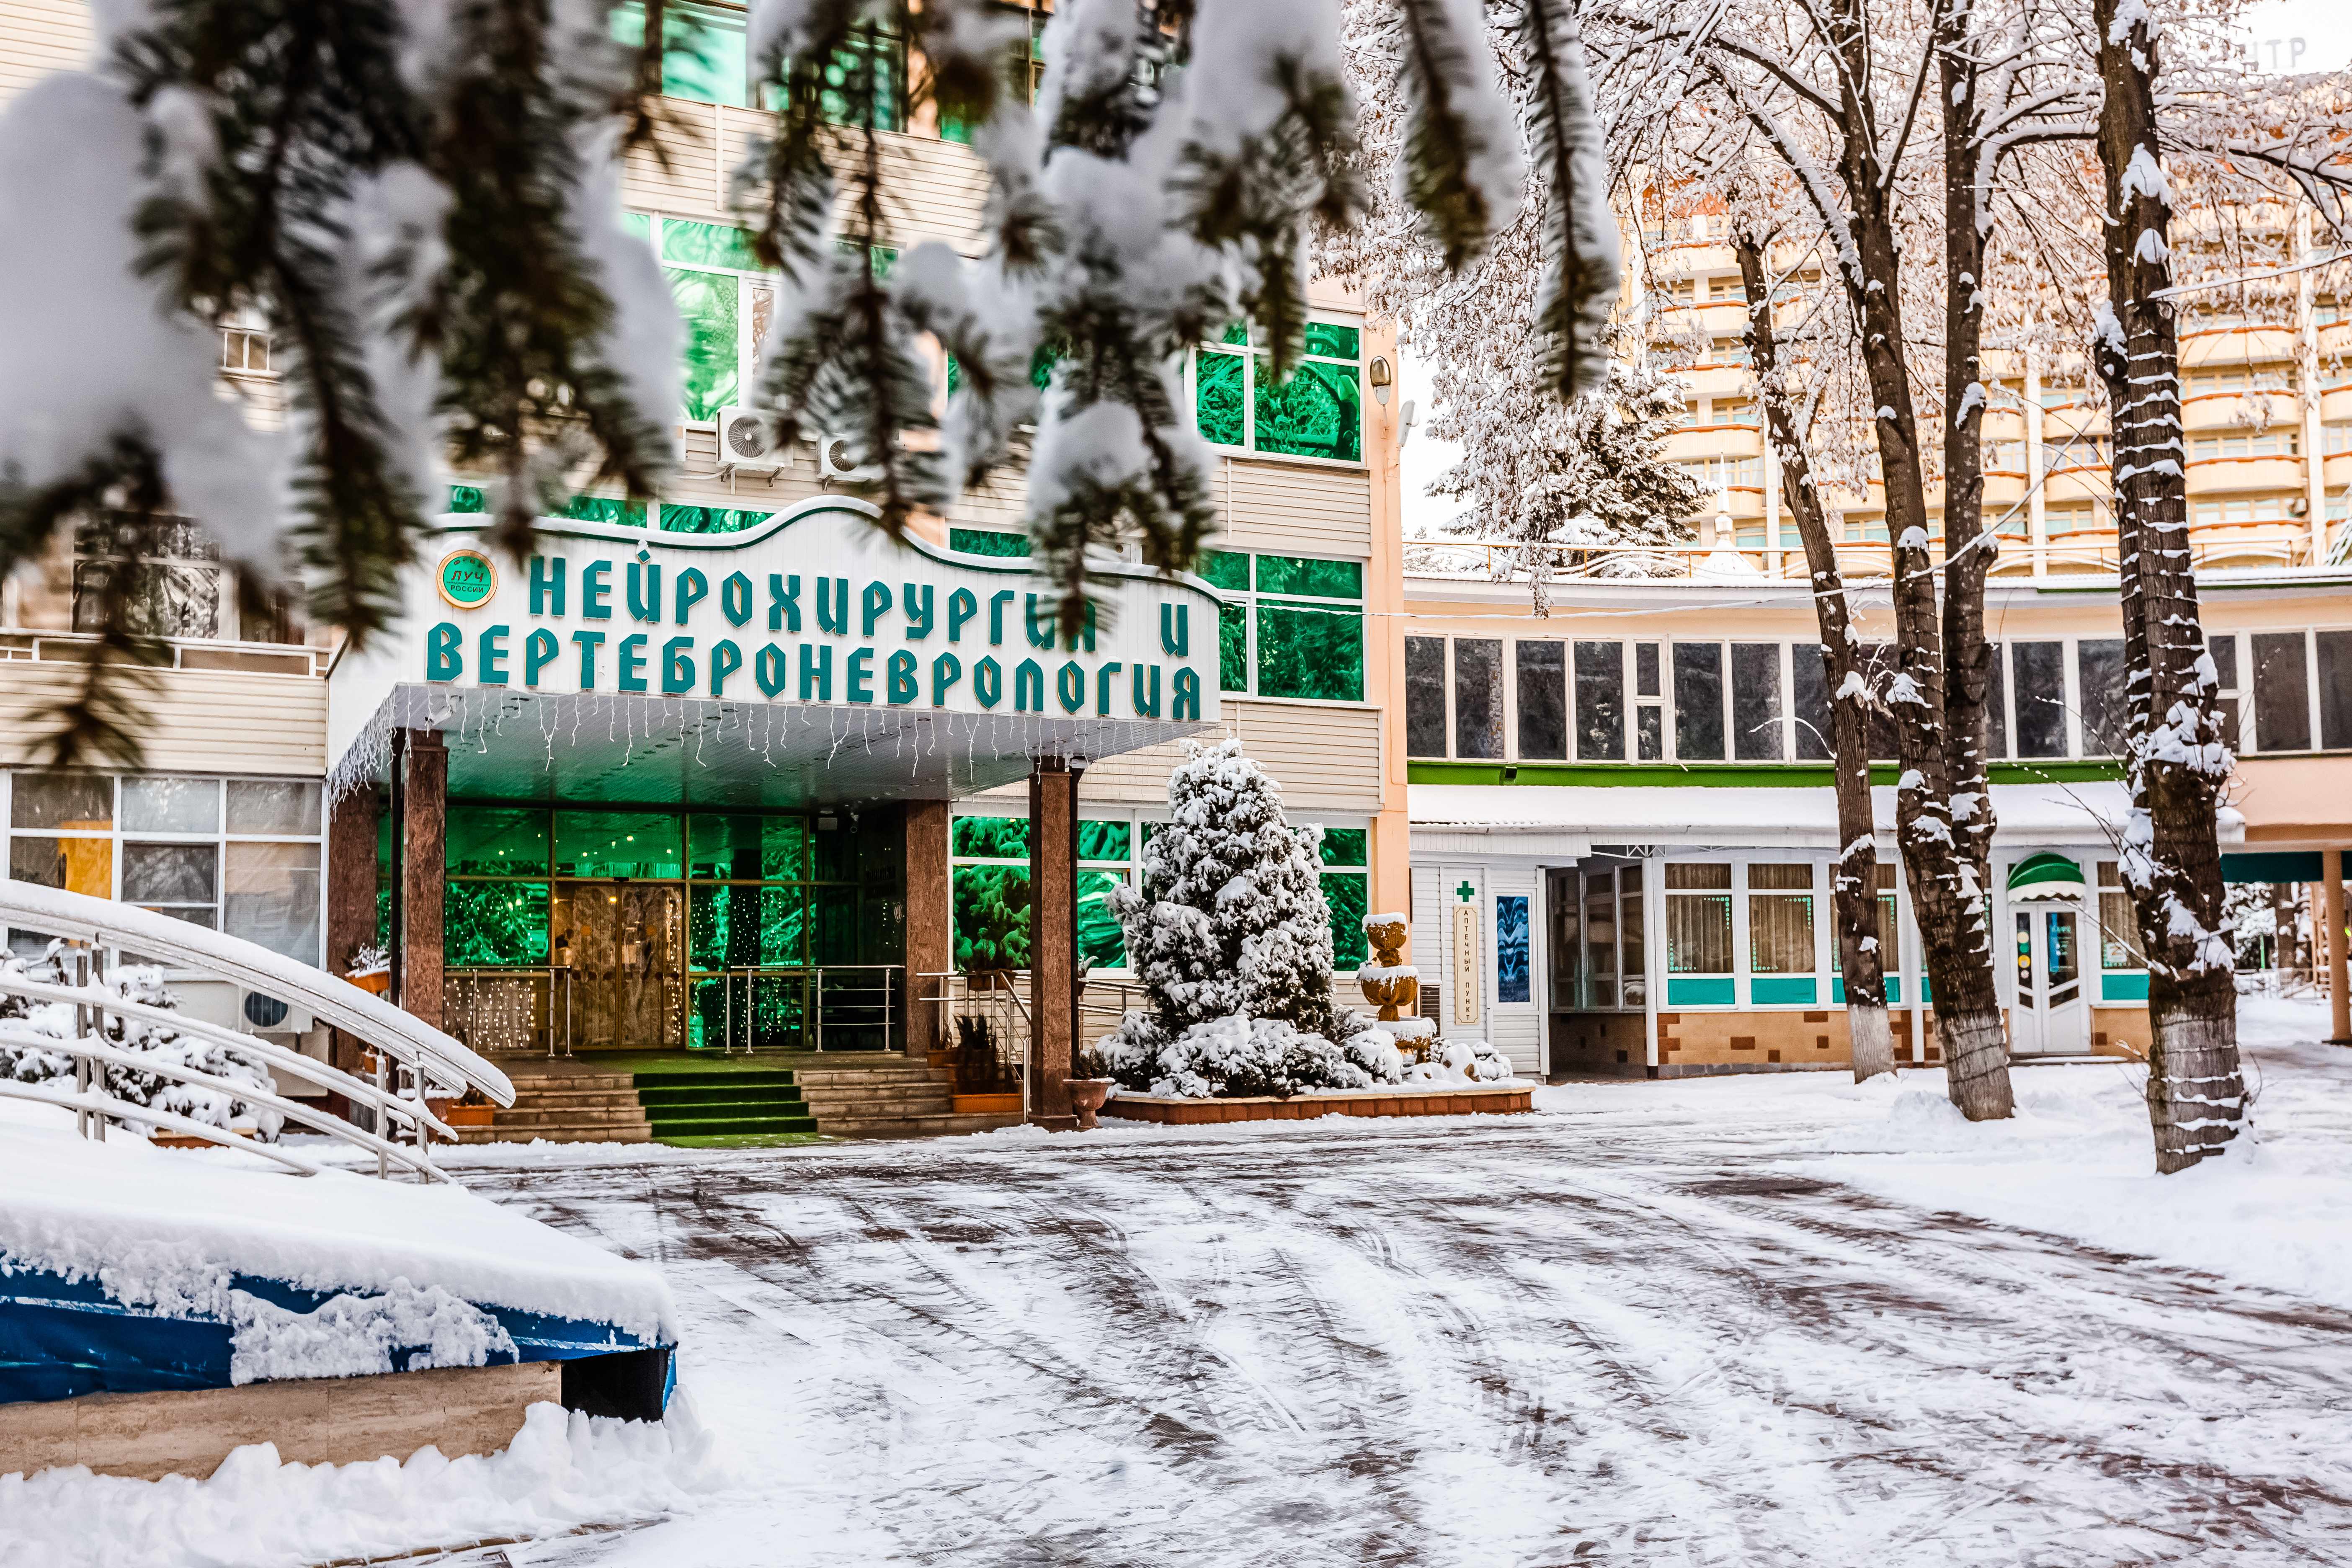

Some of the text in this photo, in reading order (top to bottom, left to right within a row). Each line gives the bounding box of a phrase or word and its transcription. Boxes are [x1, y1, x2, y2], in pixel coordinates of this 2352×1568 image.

[451, 570, 484, 583] ЛУЧ
[1160, 603, 1188, 657] И
[426, 622, 1200, 720] ВЕРТЕБРОНЕВРОЛОГИЯ
